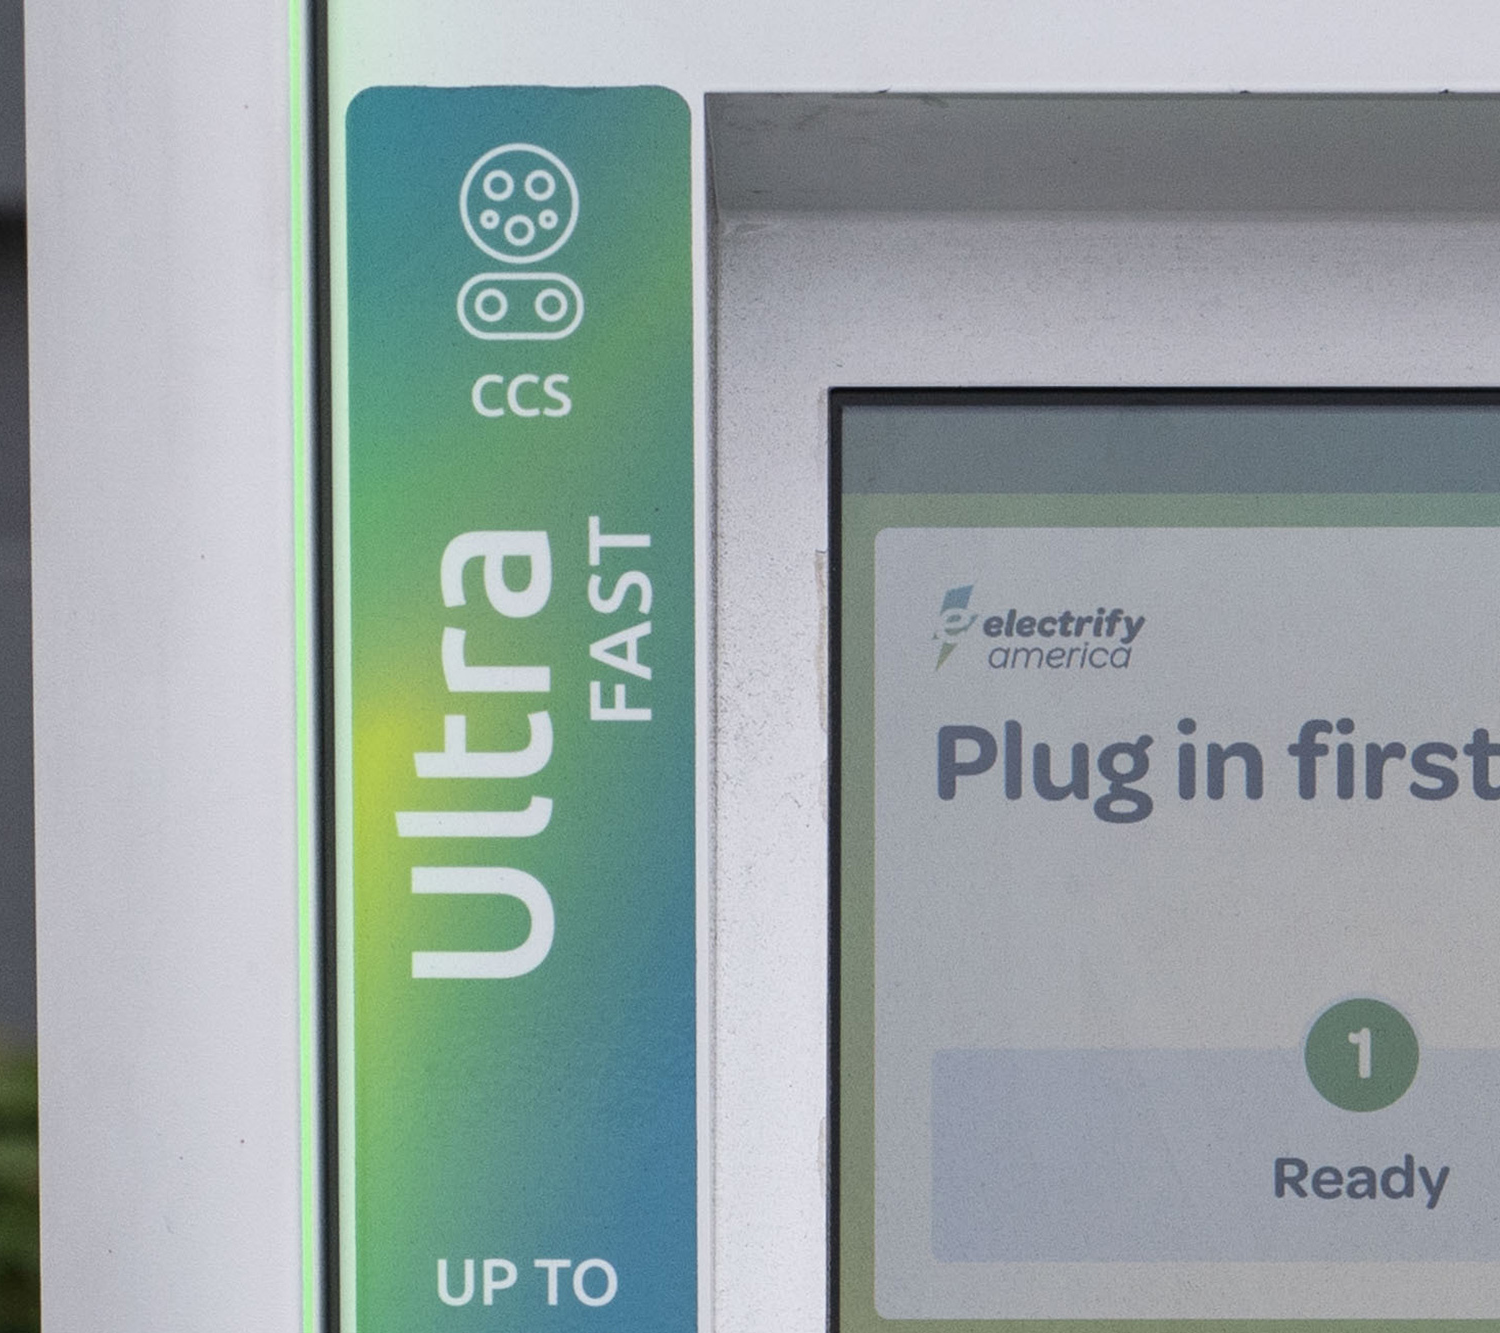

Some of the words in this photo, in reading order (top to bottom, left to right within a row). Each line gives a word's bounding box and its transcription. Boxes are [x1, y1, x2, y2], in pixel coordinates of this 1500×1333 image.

[471, 373, 572, 418] CCS
[587, 515, 653, 721] FAST
[982, 607, 1146, 645] electrify
[987, 642, 1132, 671] america
[392, 530, 555, 979] Ultra
[937, 719, 1154, 824] Plug
[1177, 717, 1264, 801] in
[1348, 1027, 1372, 1079] 1
[1274, 1153, 1451, 1210] Ready
[437, 1258, 518, 1307] UP
[533, 1258, 618, 1307] TO
